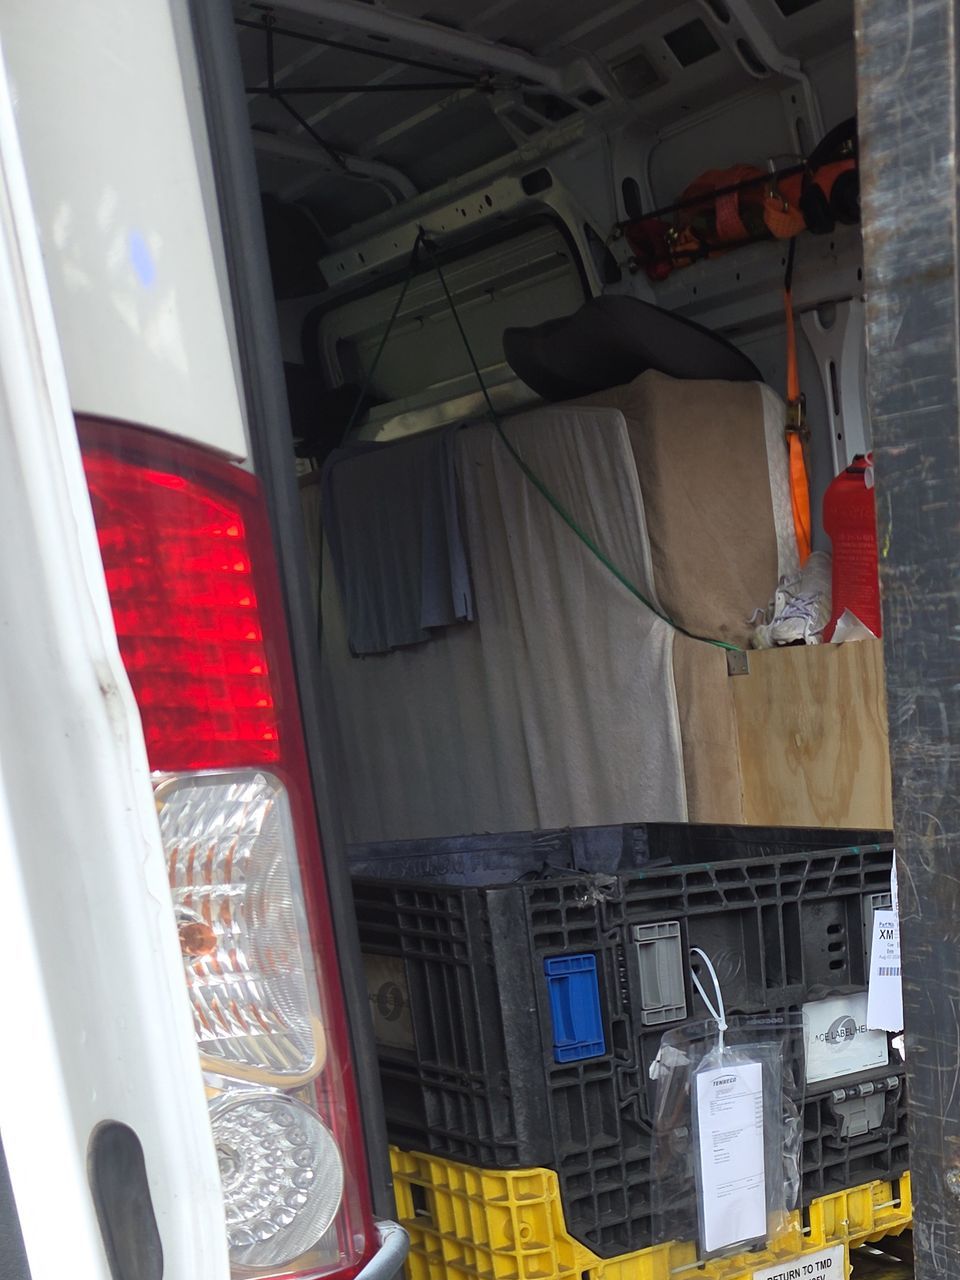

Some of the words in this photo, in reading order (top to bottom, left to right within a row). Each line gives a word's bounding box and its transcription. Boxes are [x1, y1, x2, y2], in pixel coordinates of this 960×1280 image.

[831, 1026, 856, 1040] LABEL
[802, 1263, 814, 1276] TO
[815, 1257, 833, 1271] TMD
